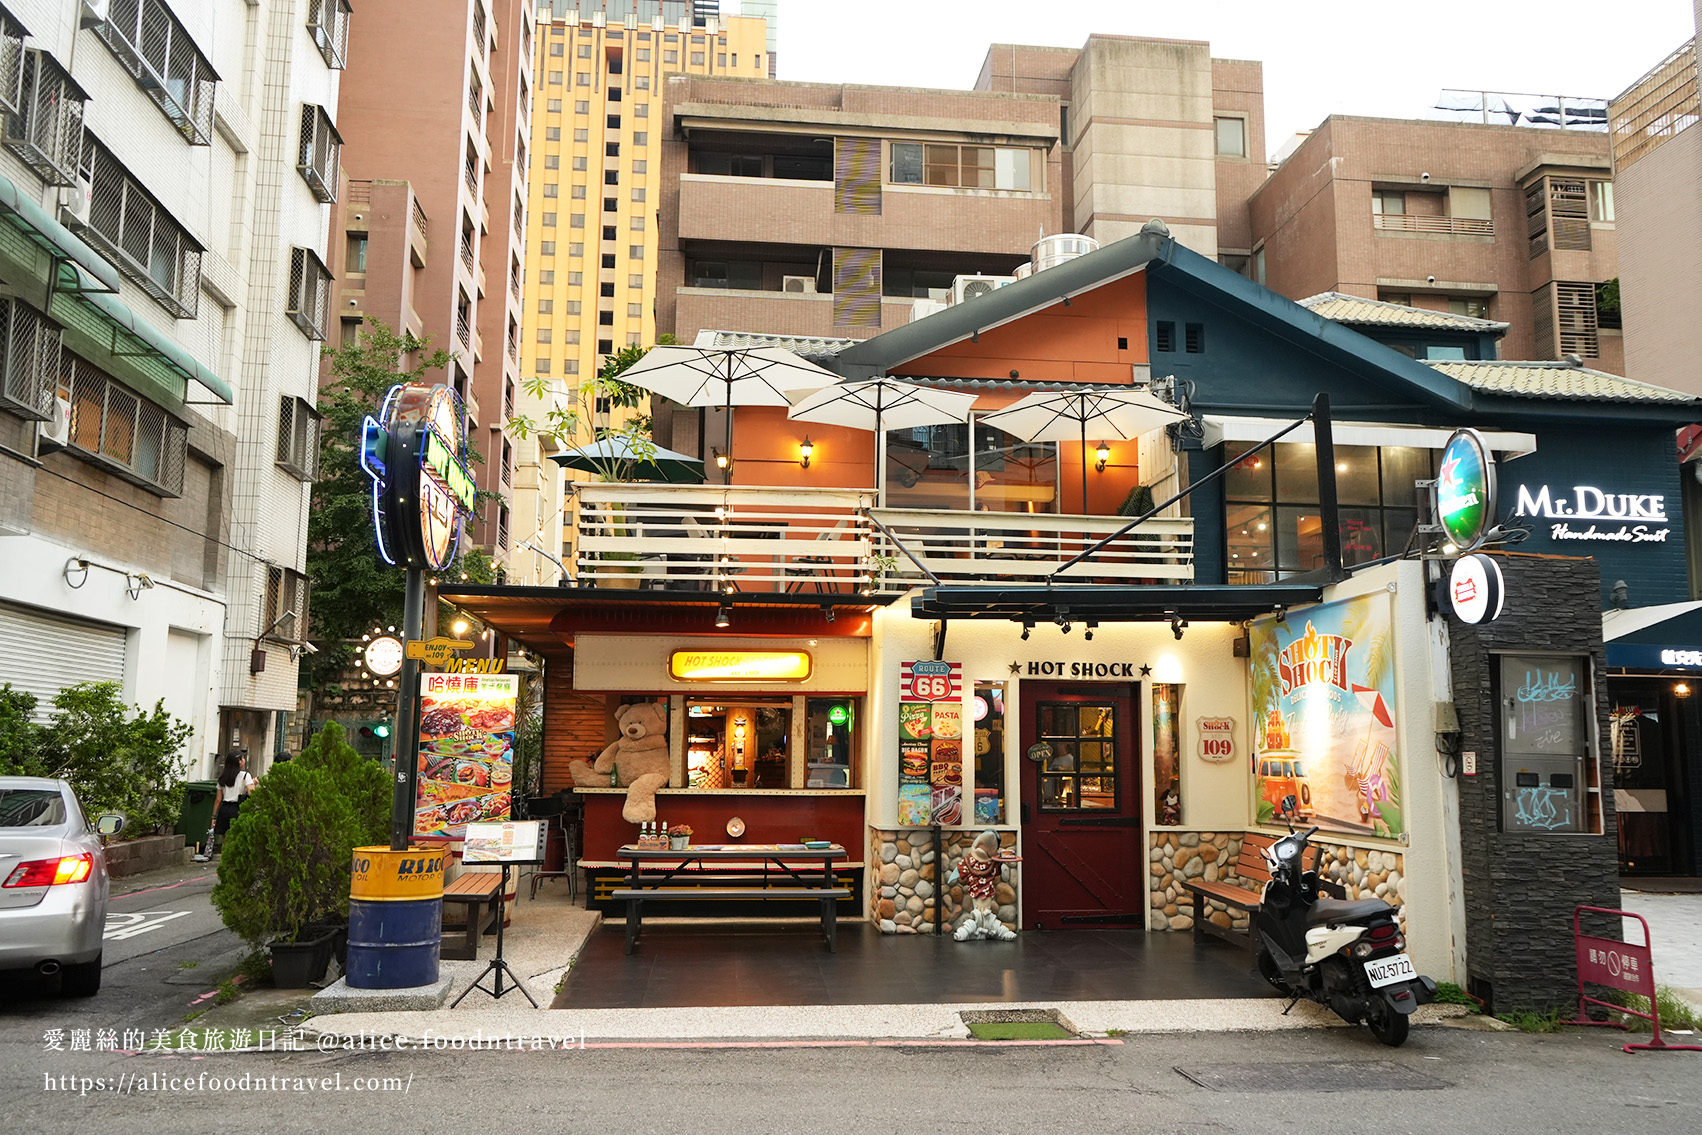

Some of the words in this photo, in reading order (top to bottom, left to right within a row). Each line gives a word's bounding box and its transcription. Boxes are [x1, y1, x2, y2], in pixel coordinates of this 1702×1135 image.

[1550, 523, 1632, 542] Handmade
[1629, 525, 1670, 543] Suit
[1288, 624, 1335, 666] HOT
[445, 658, 504, 674] MENU
[684, 656, 708, 667] HOT
[708, 656, 742, 667] SHOCK
[918, 665, 946, 673] ROUTE
[1028, 661, 1065, 676] HOT
[1071, 662, 1133, 678] SHOCK
[1279, 636, 1352, 697] SHOCK
[428, 676, 479, 694] 哈燒庫
[917, 678, 946, 696] 66
[900, 712, 925, 722] Pizza
[935, 711, 959, 719] PASTA
[1203, 721, 1230, 730] SHOCK
[1031, 749, 1051, 759] OPEN
[1203, 739, 1231, 755] 109
[397, 873, 435, 882] MOTOR
[1588, 949, 1607, 966] 請勿
[1621, 955, 1639, 971] 停車
